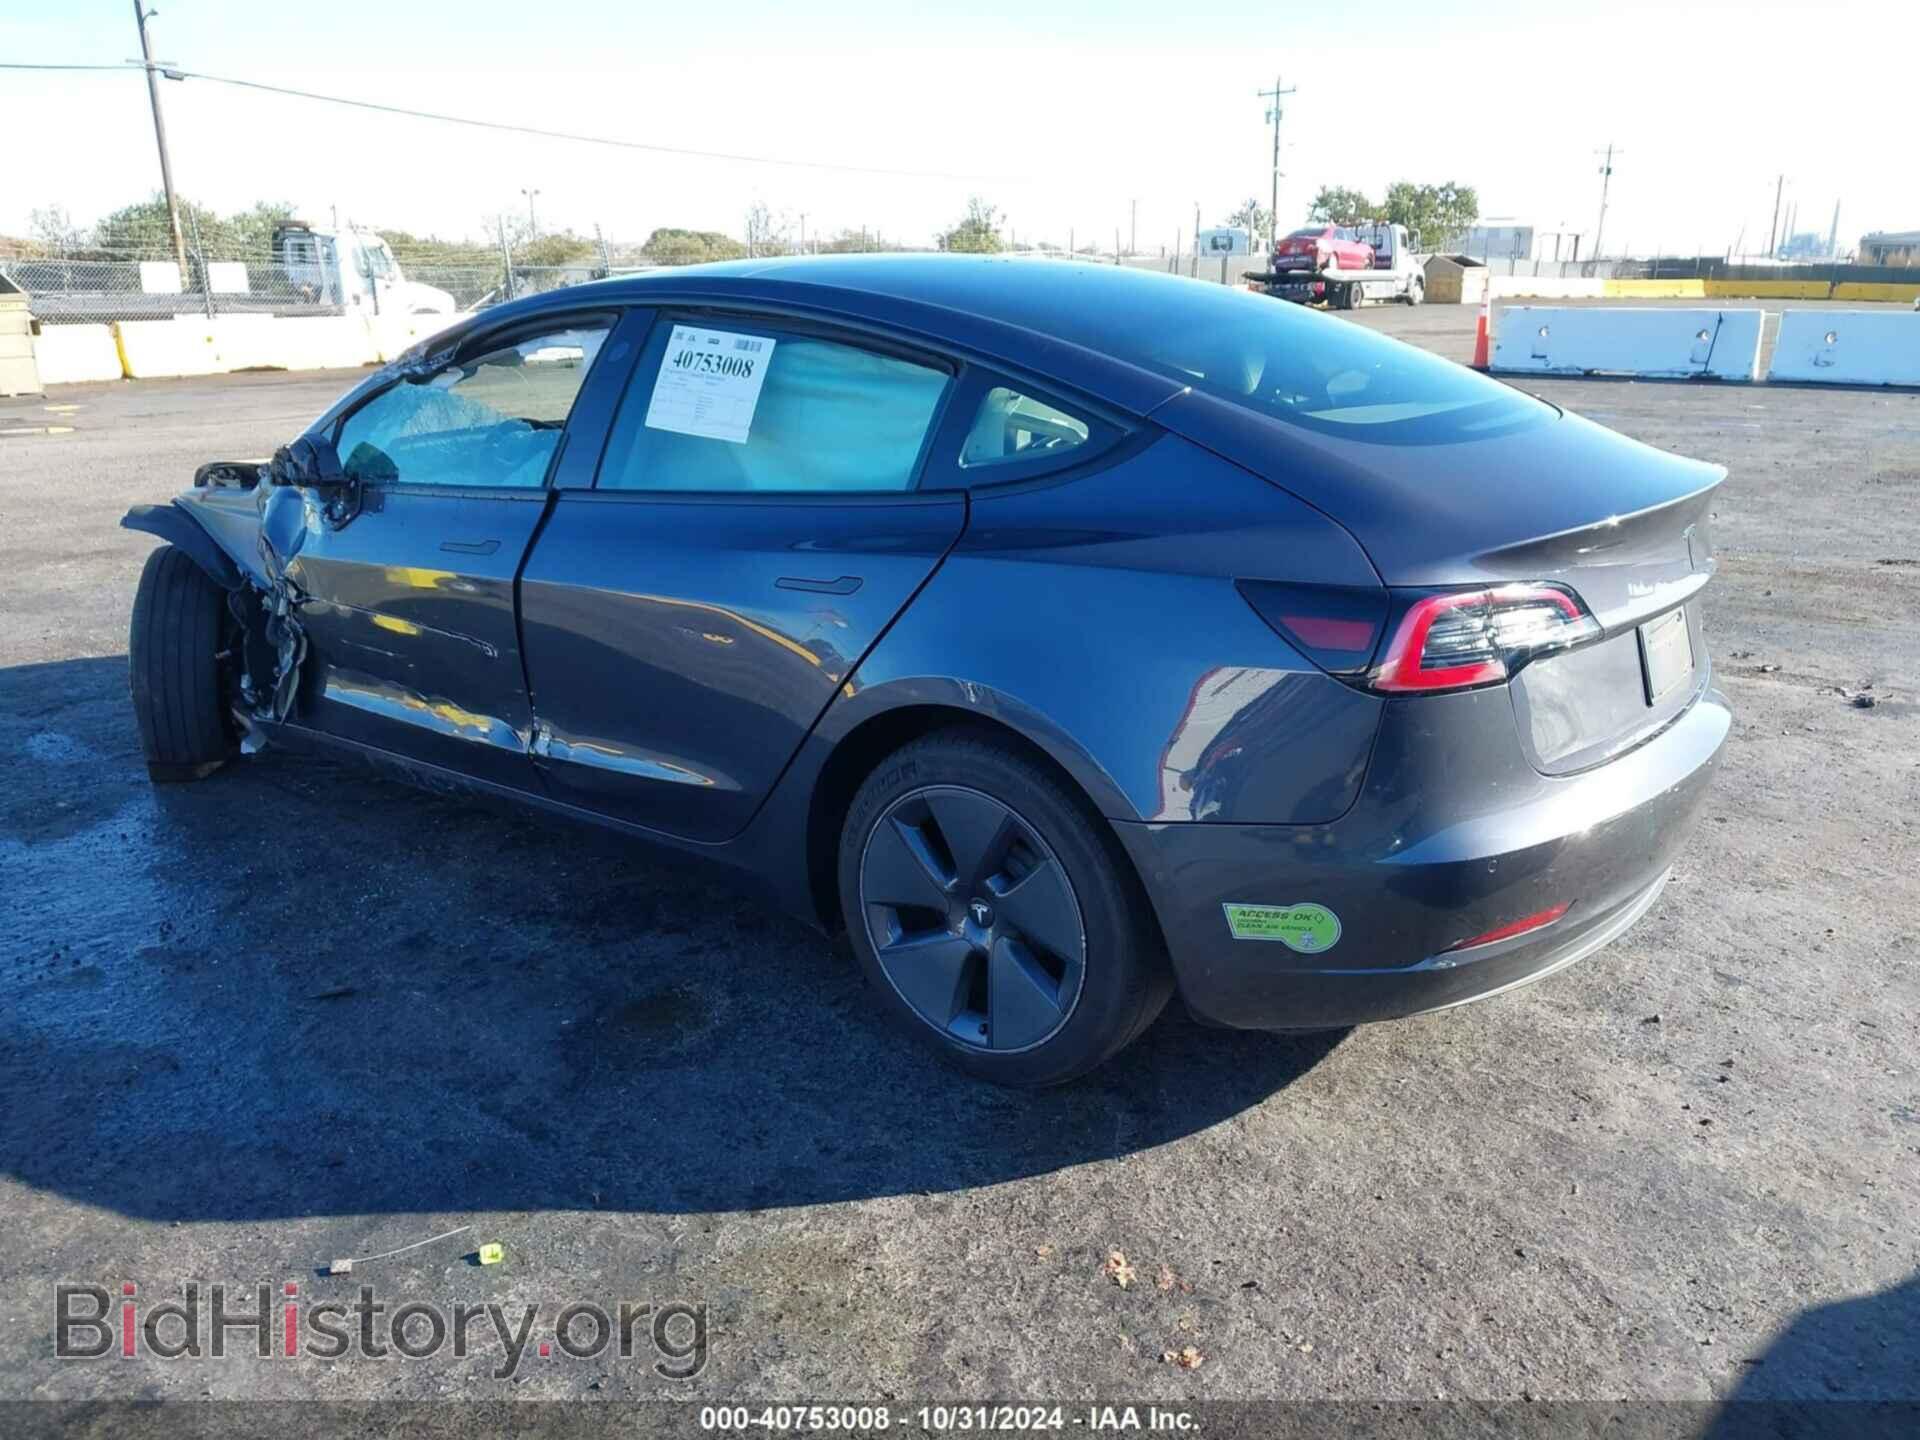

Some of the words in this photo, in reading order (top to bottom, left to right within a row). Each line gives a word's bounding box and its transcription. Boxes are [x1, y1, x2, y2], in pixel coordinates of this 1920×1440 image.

[673, 349, 754, 378] 40753008
[1239, 910, 1289, 920] ACCESS
[1294, 912, 1313, 921] OK
